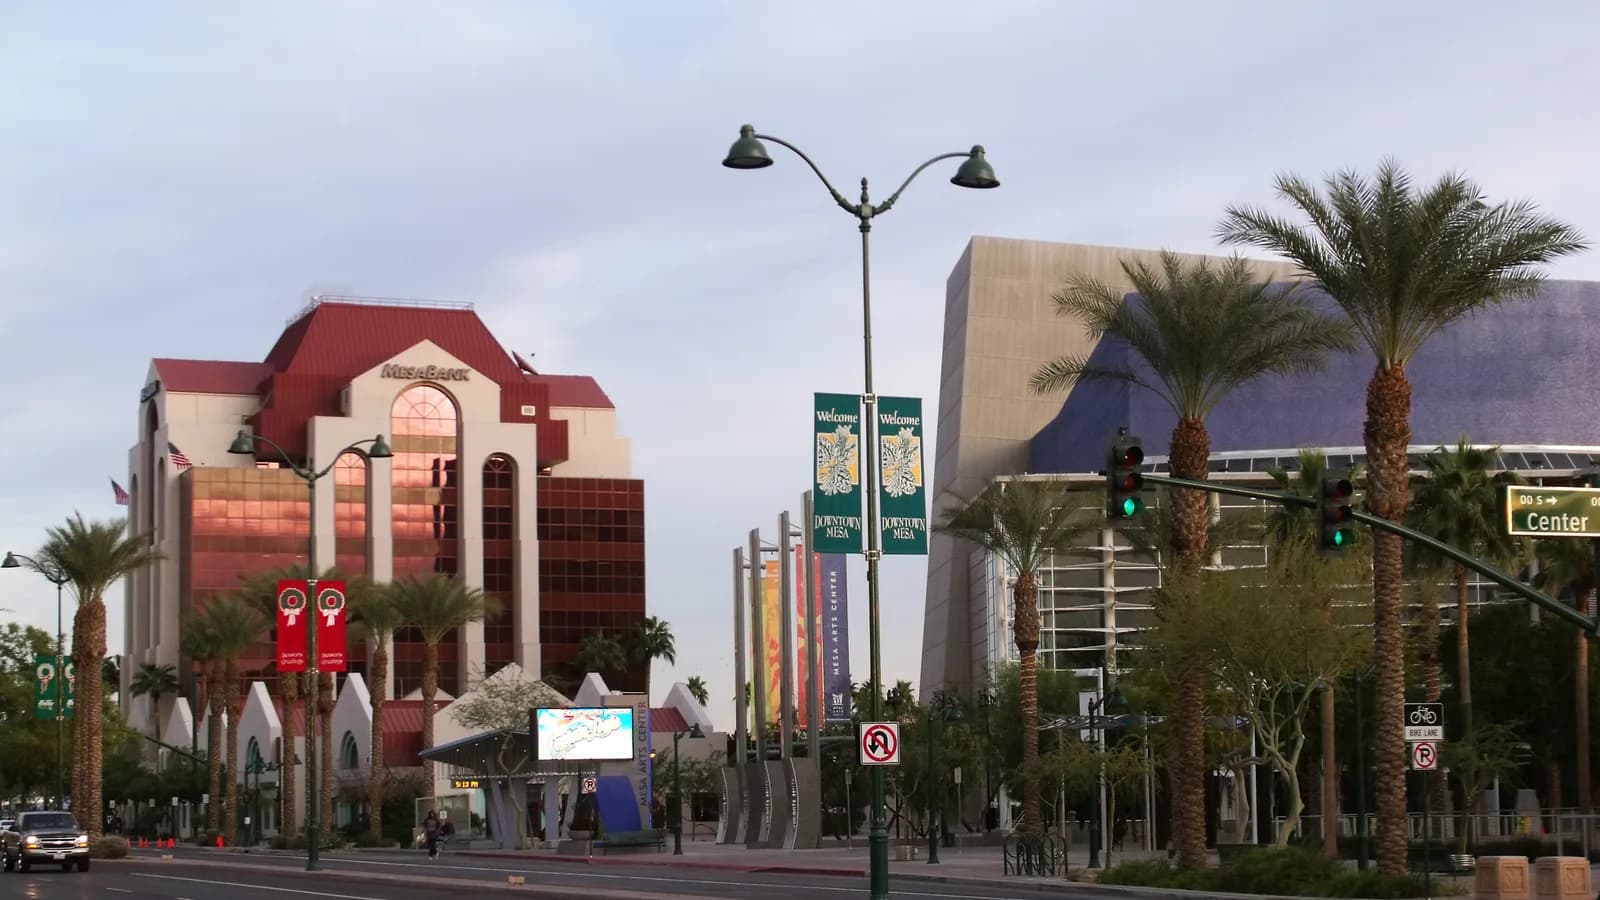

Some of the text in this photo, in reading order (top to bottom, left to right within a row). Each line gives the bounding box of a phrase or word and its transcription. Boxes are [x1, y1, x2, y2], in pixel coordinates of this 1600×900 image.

[816, 408, 858, 423] Welcome
[880, 410, 920, 425] Welcome
[1536, 495, 1543, 505] S
[815, 515, 861, 531] DOWNTOWN
[882, 517, 926, 532] DOWNTOWN
[1527, 512, 1589, 531] Center
[826, 526, 849, 538] MESA
[893, 528, 915, 539] MESA
[830, 571, 840, 676] MESA ARTS CENTER
[1410, 729, 1438, 737] BIKE LANE
[637, 702, 648, 806] MESA ARTS CENTER
